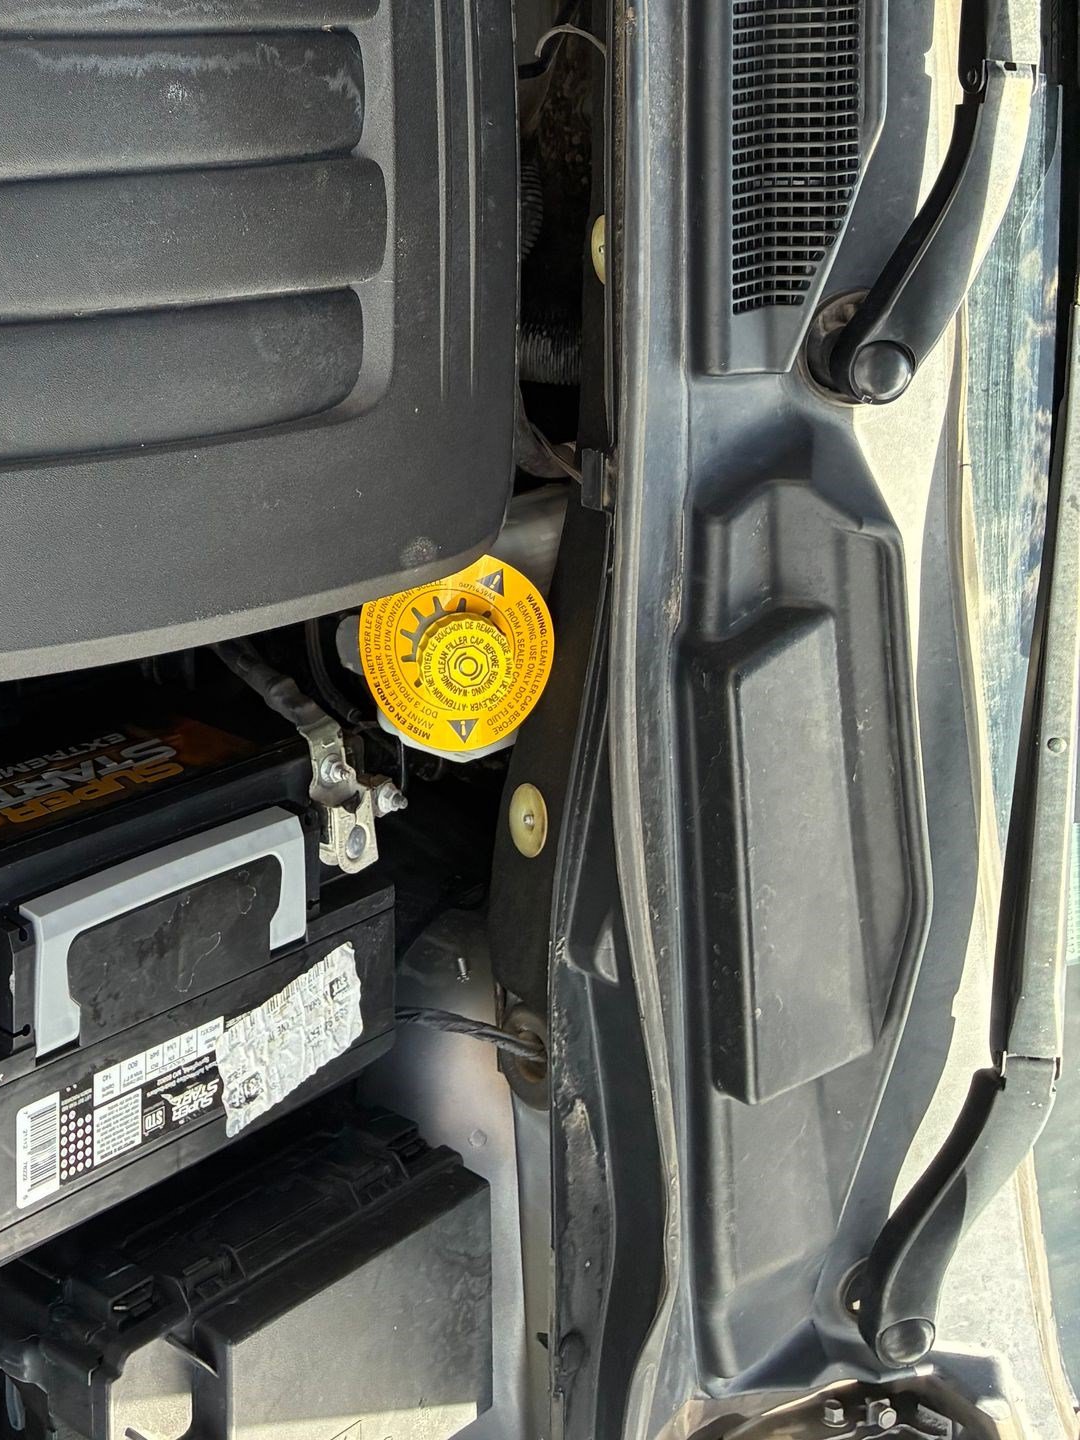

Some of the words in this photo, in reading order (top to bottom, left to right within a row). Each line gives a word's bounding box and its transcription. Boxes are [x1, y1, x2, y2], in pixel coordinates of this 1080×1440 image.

[364, 618, 372, 629] LE
[515, 600, 537, 642] REMOVING.
[526, 594, 547, 638] WARNING:
[374, 614, 384, 650] UTILISER
[384, 630, 392, 650] D'UN
[434, 623, 464, 643] BOUCHON
[470, 636, 483, 646] CAP
[476, 623, 511, 656] REMPLISSAGE
[505, 608, 522, 630] FROM
[515, 638, 525, 669] SEALED
[364, 631, 376, 674] NETTOYER
[429, 641, 438, 651] LE
[445, 636, 468, 652] FILLER
[529, 645, 537, 661] USE
[538, 640, 548, 666] CLEAN
[483, 643, 499, 669] BEFORE
[375, 654, 390, 689] RETIRER.
[386, 653, 414, 703] PROVENANT
[424, 653, 435, 688] NETTOYER
[504, 658, 513, 678] AVANT
[520, 663, 536, 685] ONLY
[471, 671, 498, 697] REMOVING
[499, 680, 508, 690] DE
[529, 668, 546, 695] FILLER
[374, 681, 395, 713] GARDE
[389, 690, 398, 700] LE
[414, 700, 420, 708] 3
[431, 689, 466, 711] ATTENTION
[513, 686, 526, 702] DOT
[519, 695, 532, 712] CAP
[397, 700, 408, 712] DE
[421, 706, 438, 718] DOT
[395, 712, 407, 723] EN
[409, 710, 434, 730] AVANT
[486, 708, 510, 726] FLUID
[492, 711, 521, 735] BEFORE
[406, 723, 431, 740] MISE
[172, 1097, 213, 1121] SUPER
[145, 1110, 163, 1130] STD
